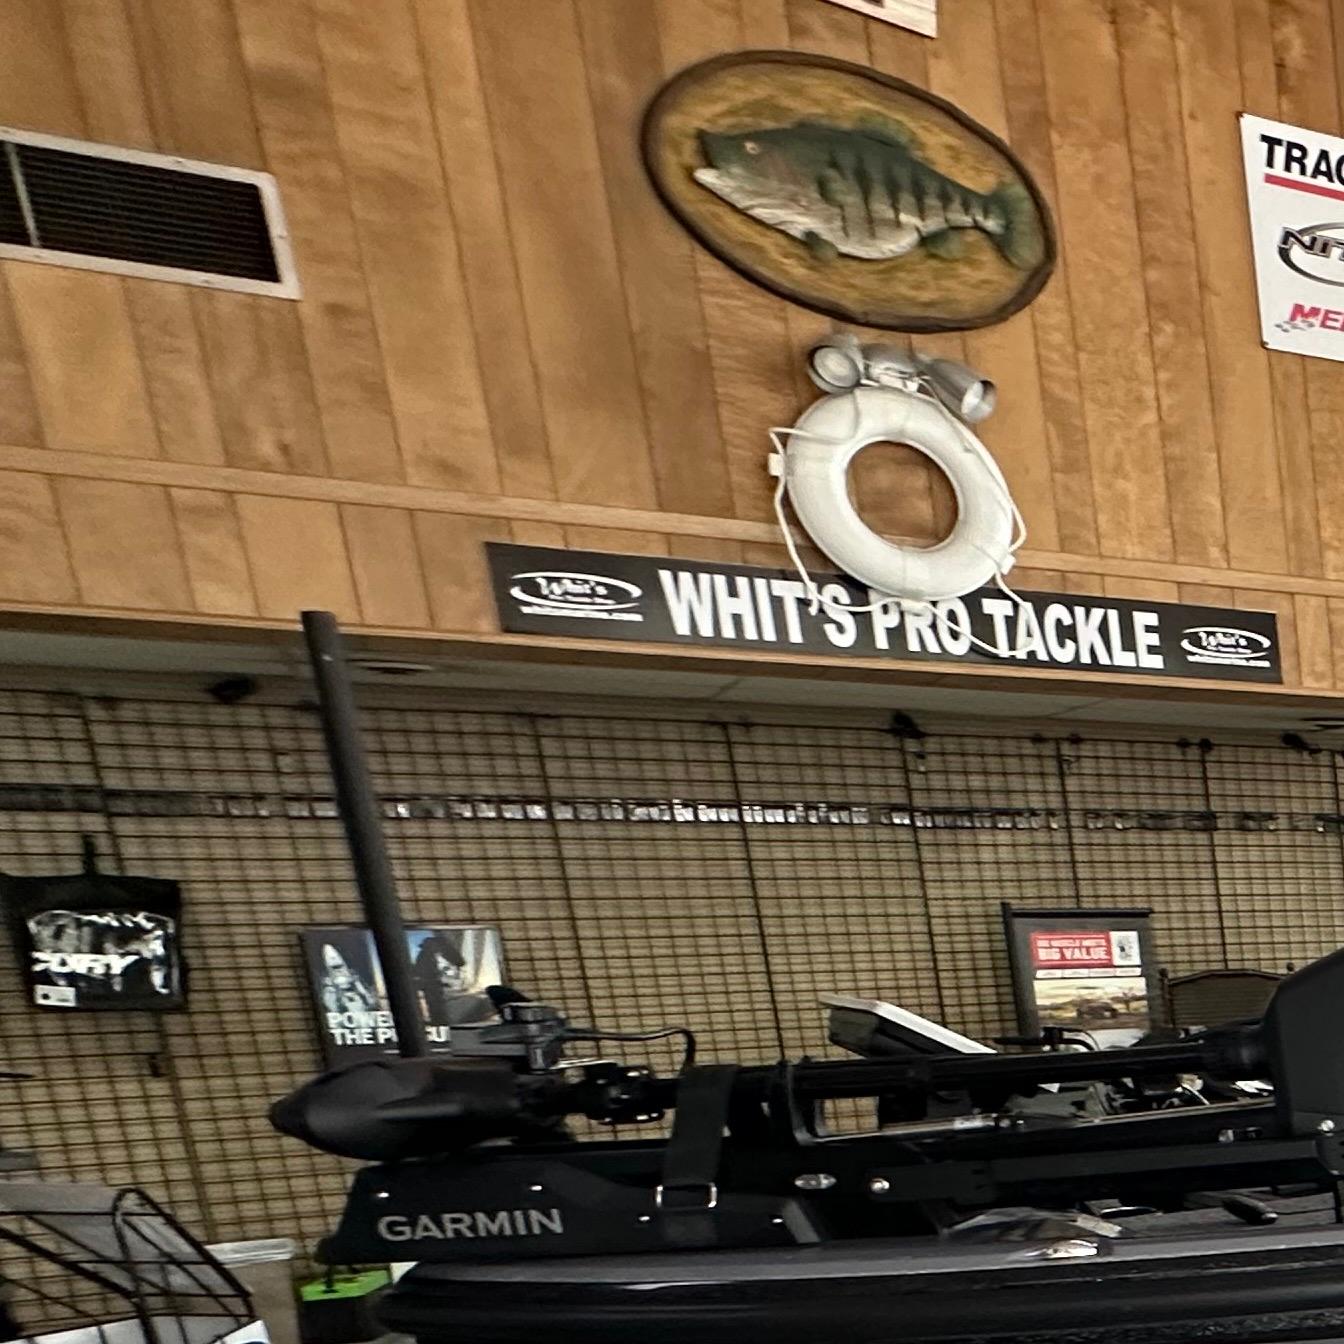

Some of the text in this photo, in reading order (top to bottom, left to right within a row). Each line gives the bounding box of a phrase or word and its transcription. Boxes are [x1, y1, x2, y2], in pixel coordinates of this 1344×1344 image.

[658, 569, 1165, 670] WHIT'S PRO TACKLE
[1062, 947, 1111, 961] VALUE
[326, 1010, 395, 1028] POWE
[330, 1029, 374, 1046] THE
[377, 1208, 564, 1242] GARMIN
